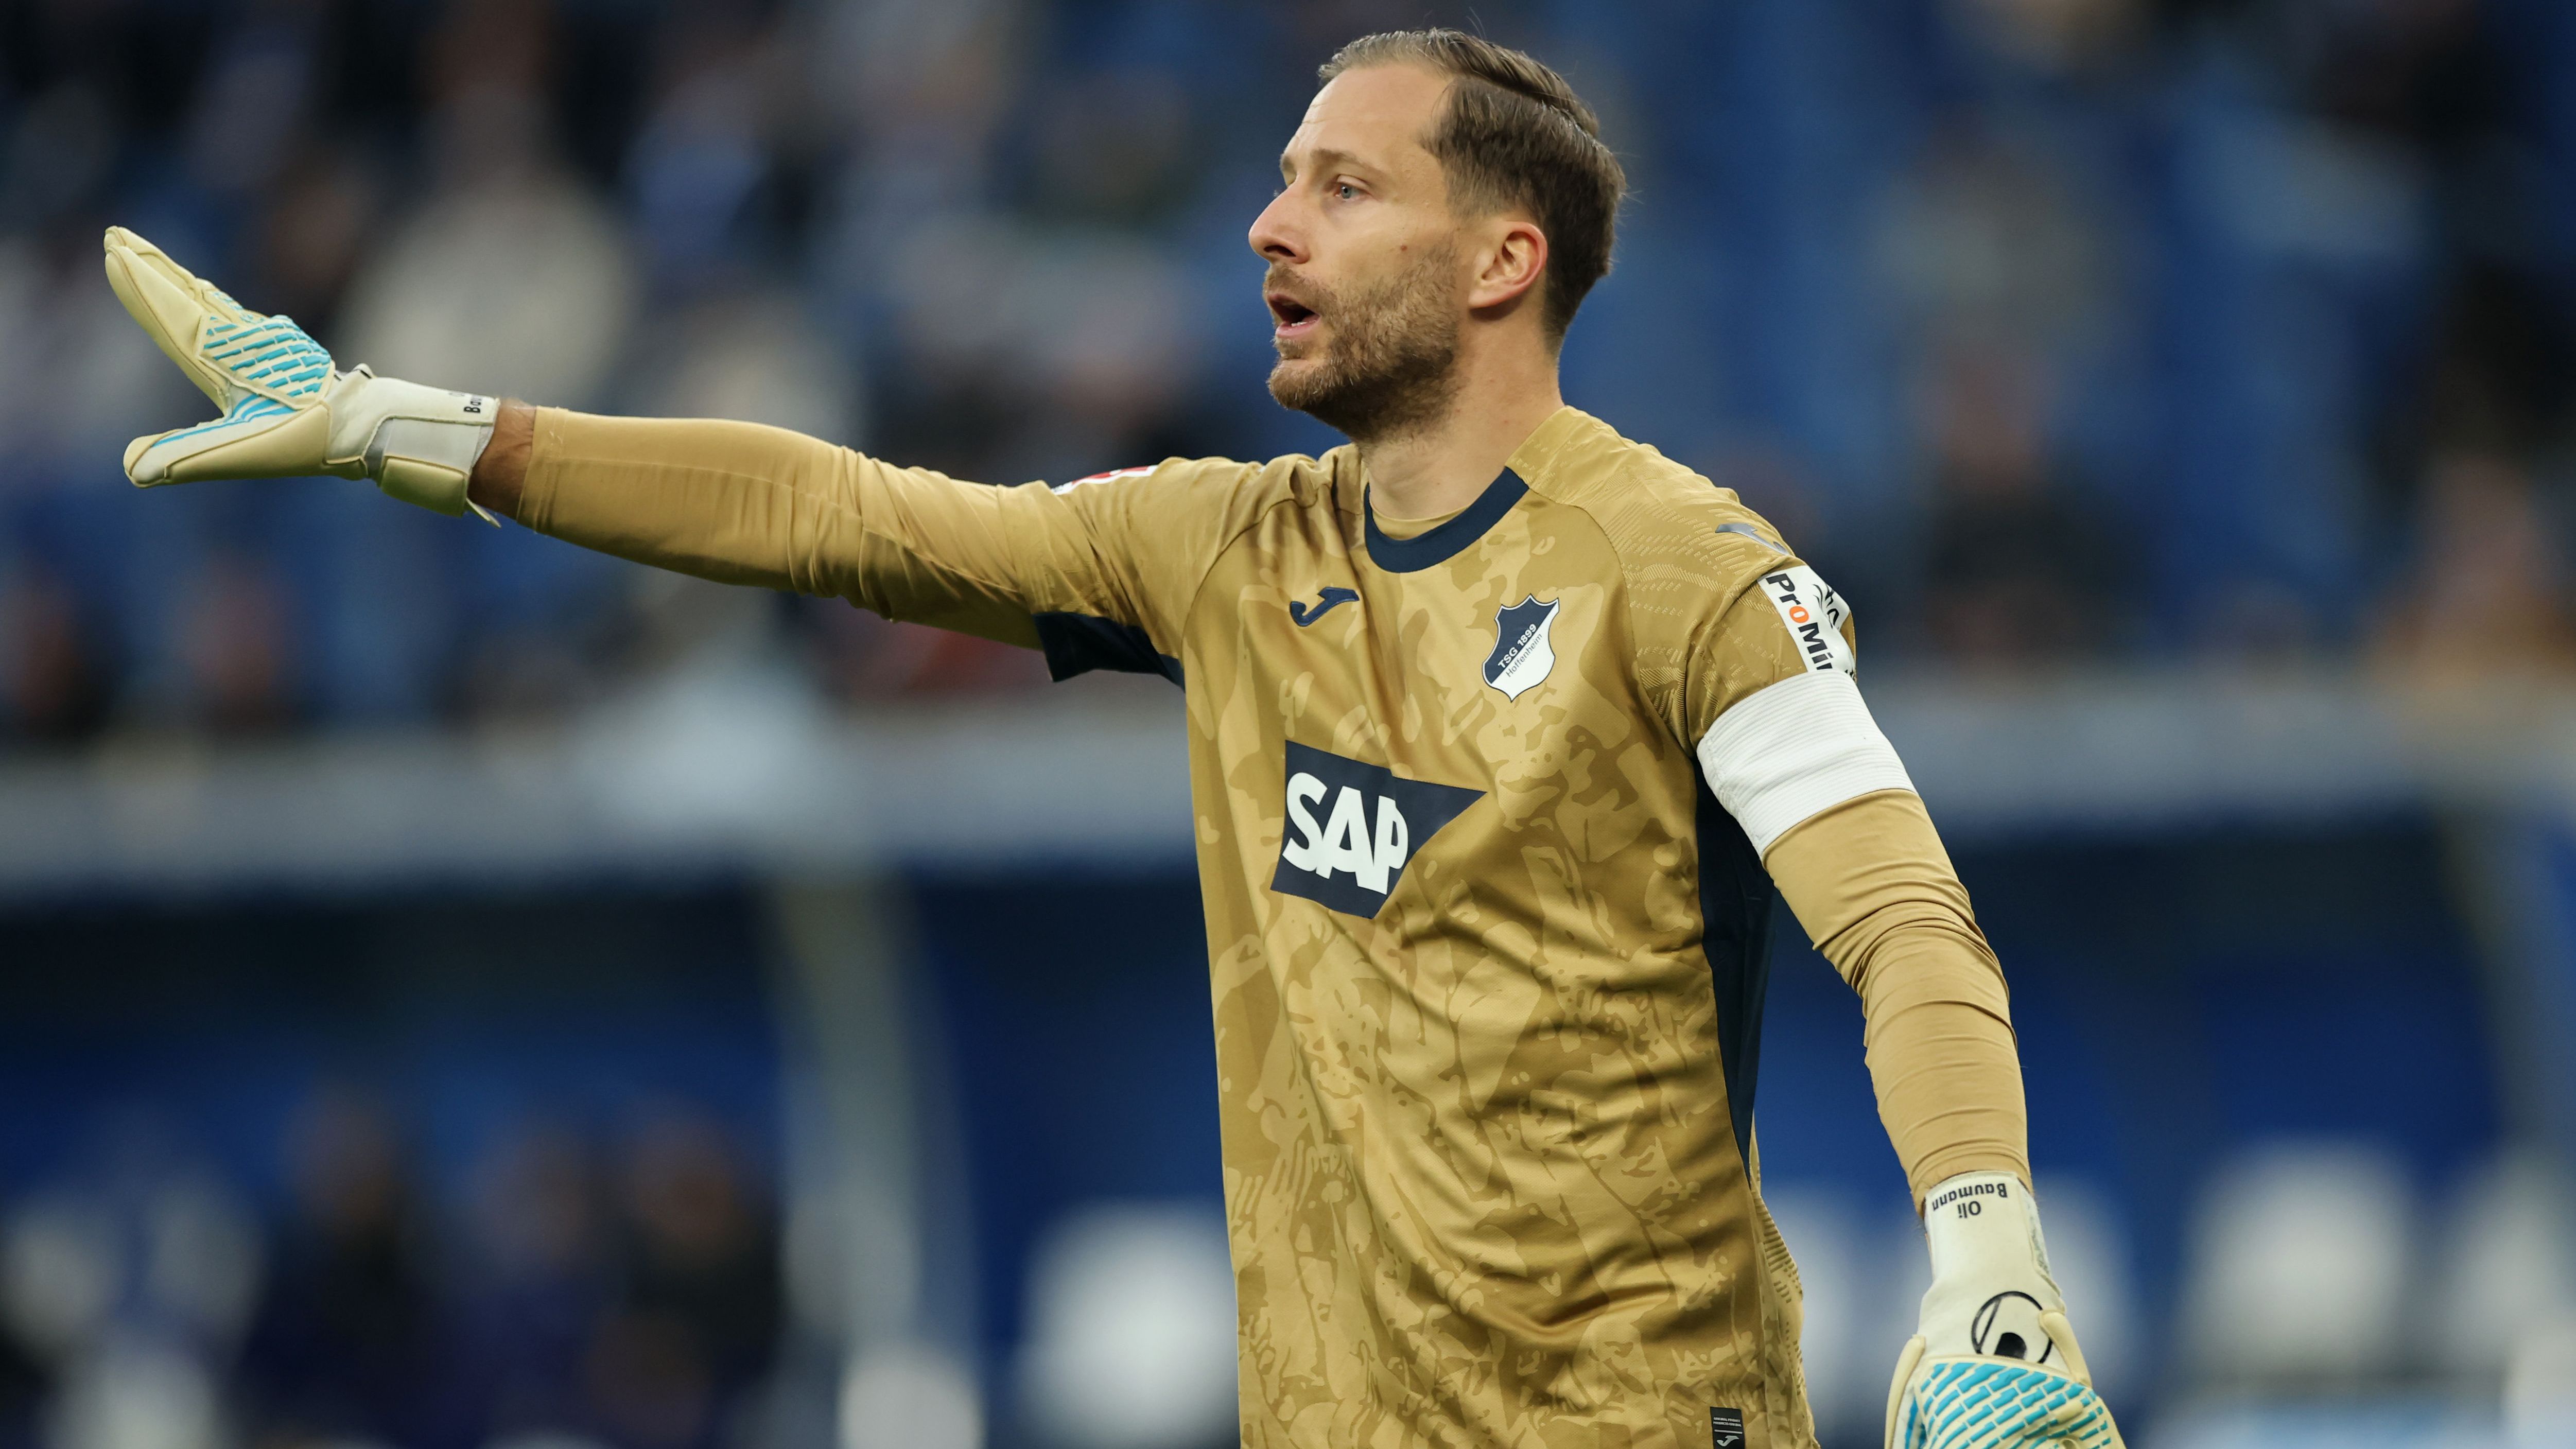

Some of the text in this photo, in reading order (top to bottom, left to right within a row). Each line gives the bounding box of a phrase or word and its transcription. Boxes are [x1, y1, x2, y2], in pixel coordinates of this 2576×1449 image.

[1498, 623, 1537, 668] TSG 1899
[1506, 633, 1542, 677] Hoffenheim
[1282, 772, 1408, 895] SAP
[1932, 1183, 2008, 1211] Baumann
[1958, 1201, 1981, 1218] Oli
